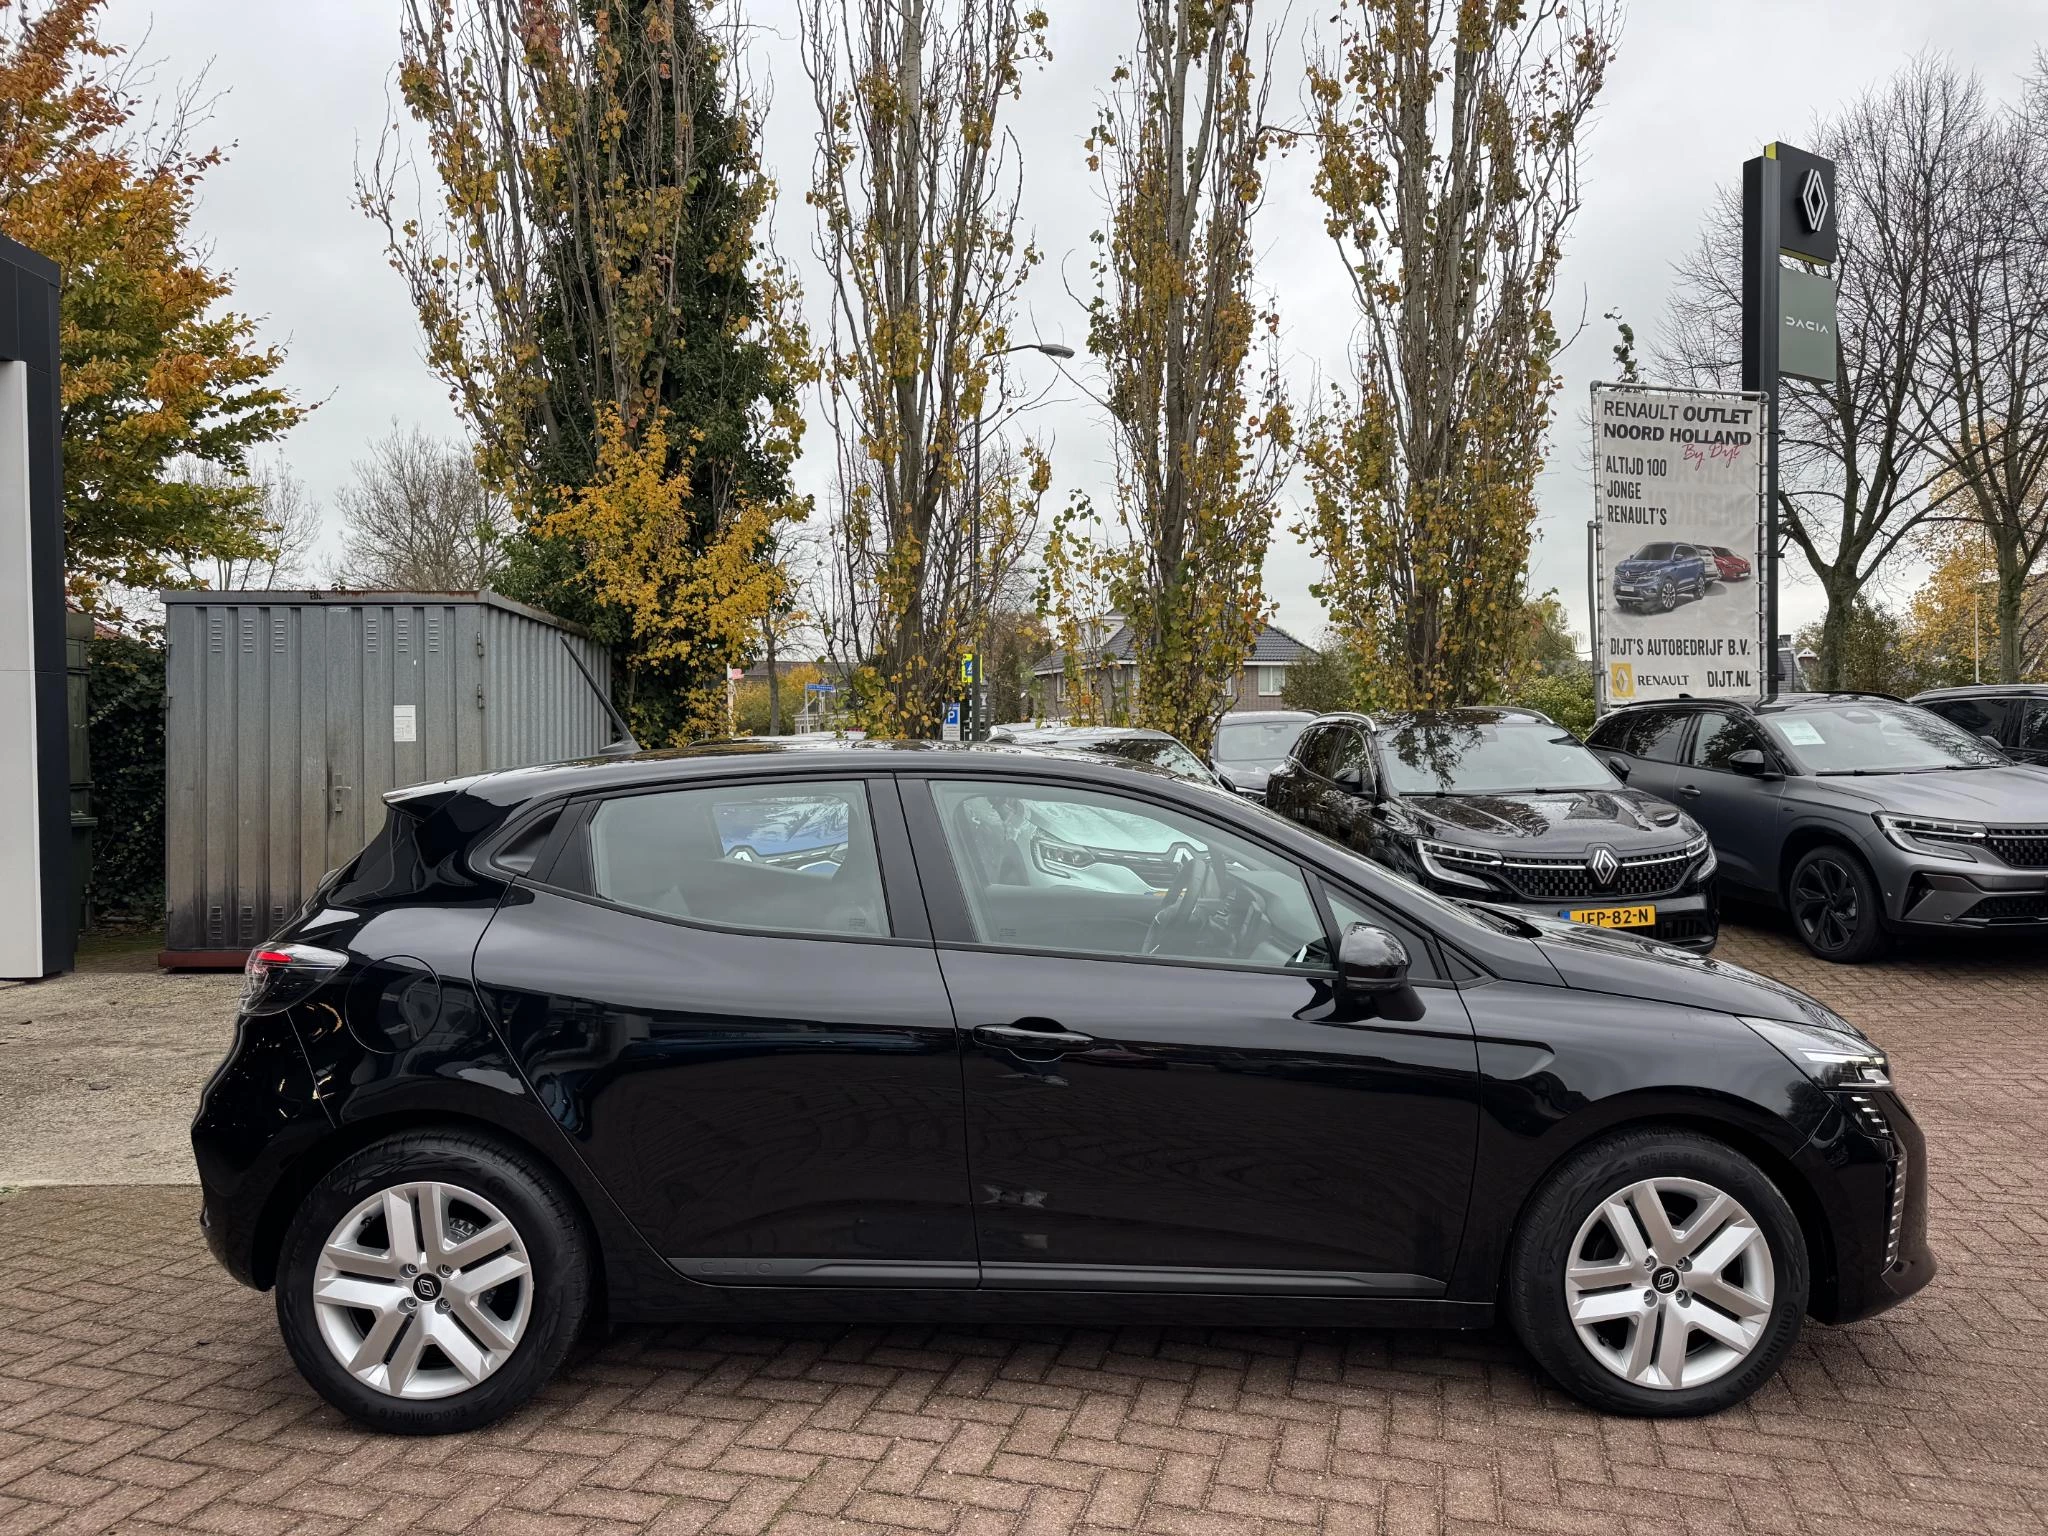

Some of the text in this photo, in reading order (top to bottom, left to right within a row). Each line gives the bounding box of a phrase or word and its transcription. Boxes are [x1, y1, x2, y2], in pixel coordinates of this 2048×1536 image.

[1785, 315, 1829, 334] DACIA
[1604, 400, 1753, 425] RENAULT OUTLET
[1603, 423, 1752, 446] NOORD HOLLAND
[1606, 455, 1667, 477] ALTIJD 100
[1682, 444, 1705, 471] By
[1607, 480, 1642, 500] JONGE
[1607, 504, 1667, 526] RENAULT'S
[1610, 637, 1751, 656] DIJT'S AUTOBEDRIJF B.V.
[1637, 675, 1690, 686] RENAULT
[1707, 670, 1751, 688] DIJT.NL
[698, 1261, 776, 1275] CLIO
